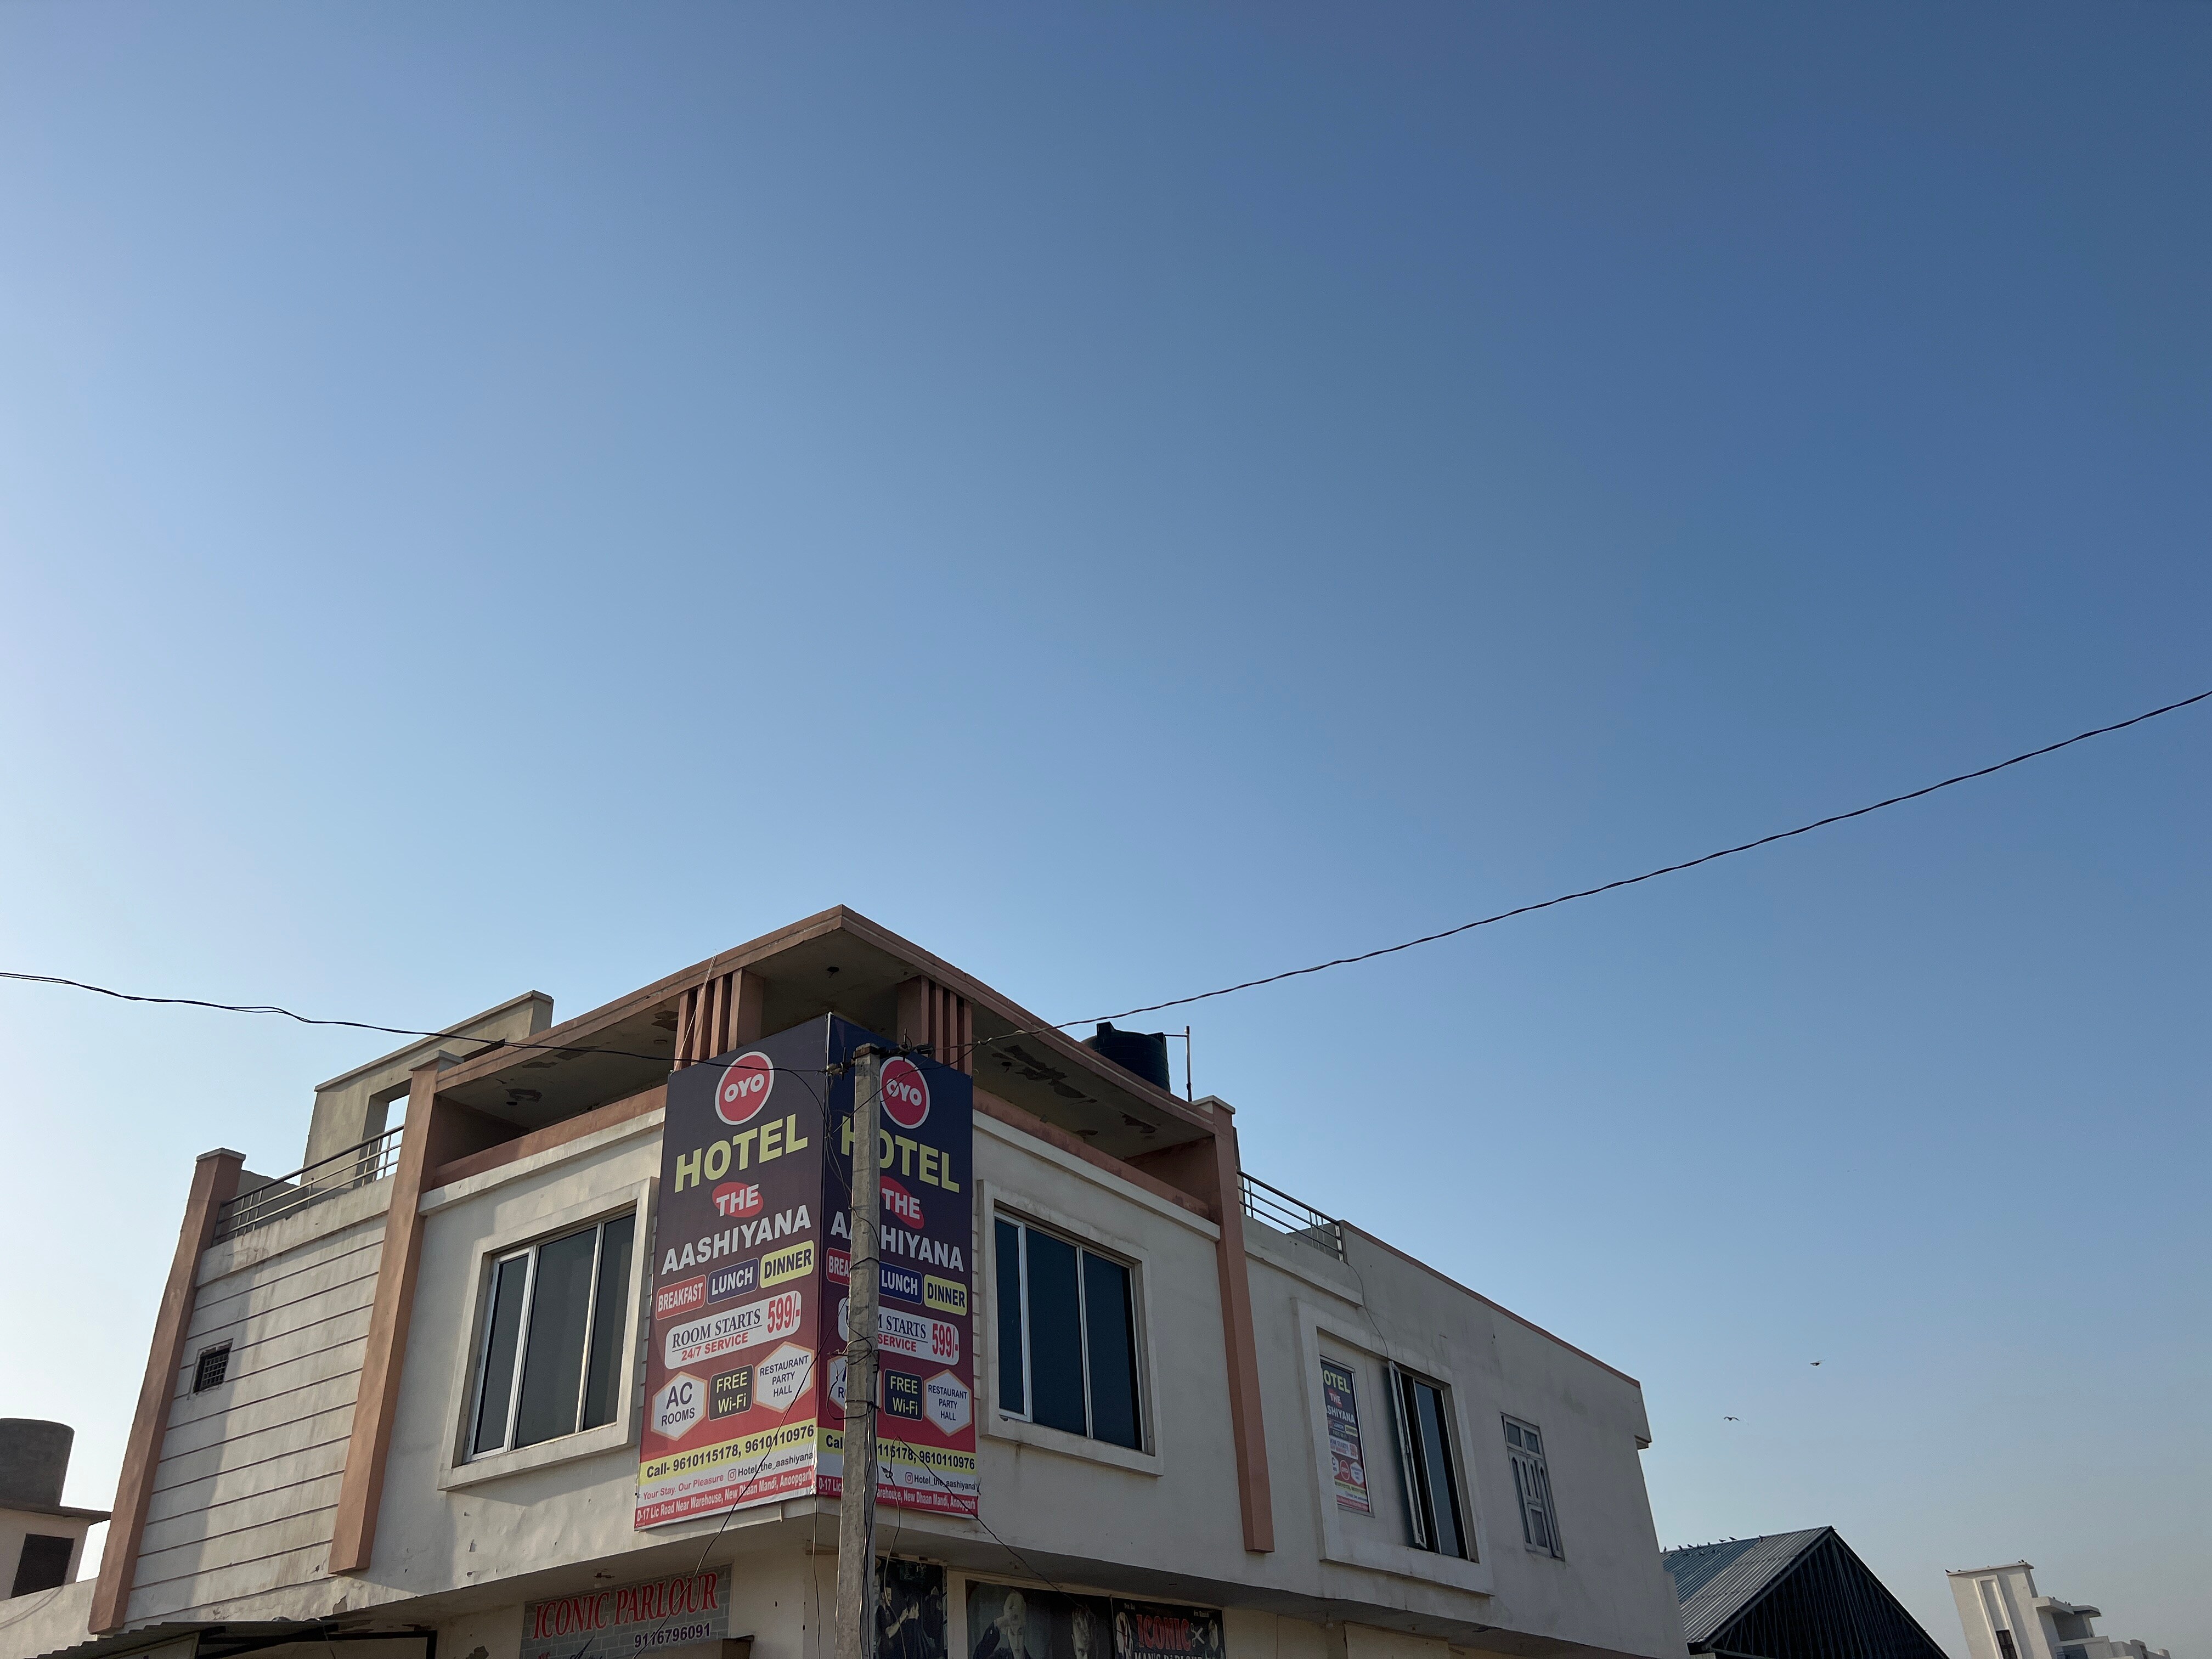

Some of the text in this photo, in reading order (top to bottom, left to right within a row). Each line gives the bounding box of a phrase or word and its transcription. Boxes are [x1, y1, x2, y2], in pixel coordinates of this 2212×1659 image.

[724, 1074, 764, 1102] OYO
[886, 1079, 922, 1106] OYO
[675, 1114, 808, 1193] HOTEL
[716, 1183, 759, 1217] THE
[882, 1188, 920, 1220] THE
[661, 1204, 811, 1275] AASHIYANA
[830, 1211, 964, 1272] AHIYANA
[764, 1248, 812, 1279] DINNER
[712, 1266, 753, 1295] LUNCH
[881, 1269, 918, 1296] LUNCH
[658, 1282, 703, 1312] BREAKFAST
[927, 1282, 966, 1308] DINNER
[767, 1293, 800, 1333] 599/-
[672, 1308, 761, 1348] ROOM STARTS
[886, 1315, 927, 1339] STARTS
[681, 1332, 748, 1361] 24/7 SERVICE
[878, 1333, 917, 1352] SERVICE
[932, 1323, 958, 1359] 599/-
[760, 1355, 809, 1376] RESTAURANT
[772, 1371, 795, 1385] PARTY
[666, 1381, 693, 1409] AC
[716, 1372, 748, 1393] FREE
[773, 1385, 792, 1397] HALL
[890, 1375, 918, 1395] FREE
[928, 1384, 968, 1400] RESTAURANT
[1323, 1369, 1351, 1394] OTEL
[718, 1393, 747, 1414] Wi-Fi
[892, 1396, 918, 1415] Wi-Fi
[939, 1398, 957, 1409] PARTY
[1329, 1392, 1342, 1404] THE
[661, 1407, 695, 1426] ROOMS
[940, 1410, 956, 1421] HALL
[1327, 1404, 1356, 1424] SHIYANA
[647, 1424, 814, 1478] Call- 9610115178, 9610110976
[919, 1451, 975, 1470] 9610110976
[644, 1488, 658, 1500] Your
[678, 1480, 692, 1492] Our
[693, 1474, 724, 1488] Pleasure
[819, 1477, 832, 1491] D-17
[833, 1479, 842, 1492] Lic
[877, 1486, 902, 1503] arehoue,
[904, 1489, 916, 1502] New
[916, 1491, 932, 1505] Dhaan
[637, 1508, 650, 1522] D-17
[651, 1506, 659, 1519] Lic
[661, 1503, 675, 1516] Road
[676, 1499, 689, 1511] Near
[690, 1492, 723, 1508] Warehouse,
[725, 1487, 737, 1501] New
[739, 1483, 758, 1498] Dhaan
[532, 1572, 719, 1640] ICONIC PARLOUR
[634, 1622, 711, 1650] 9116796091
[1136, 1615, 1192, 1651] ICONIC
